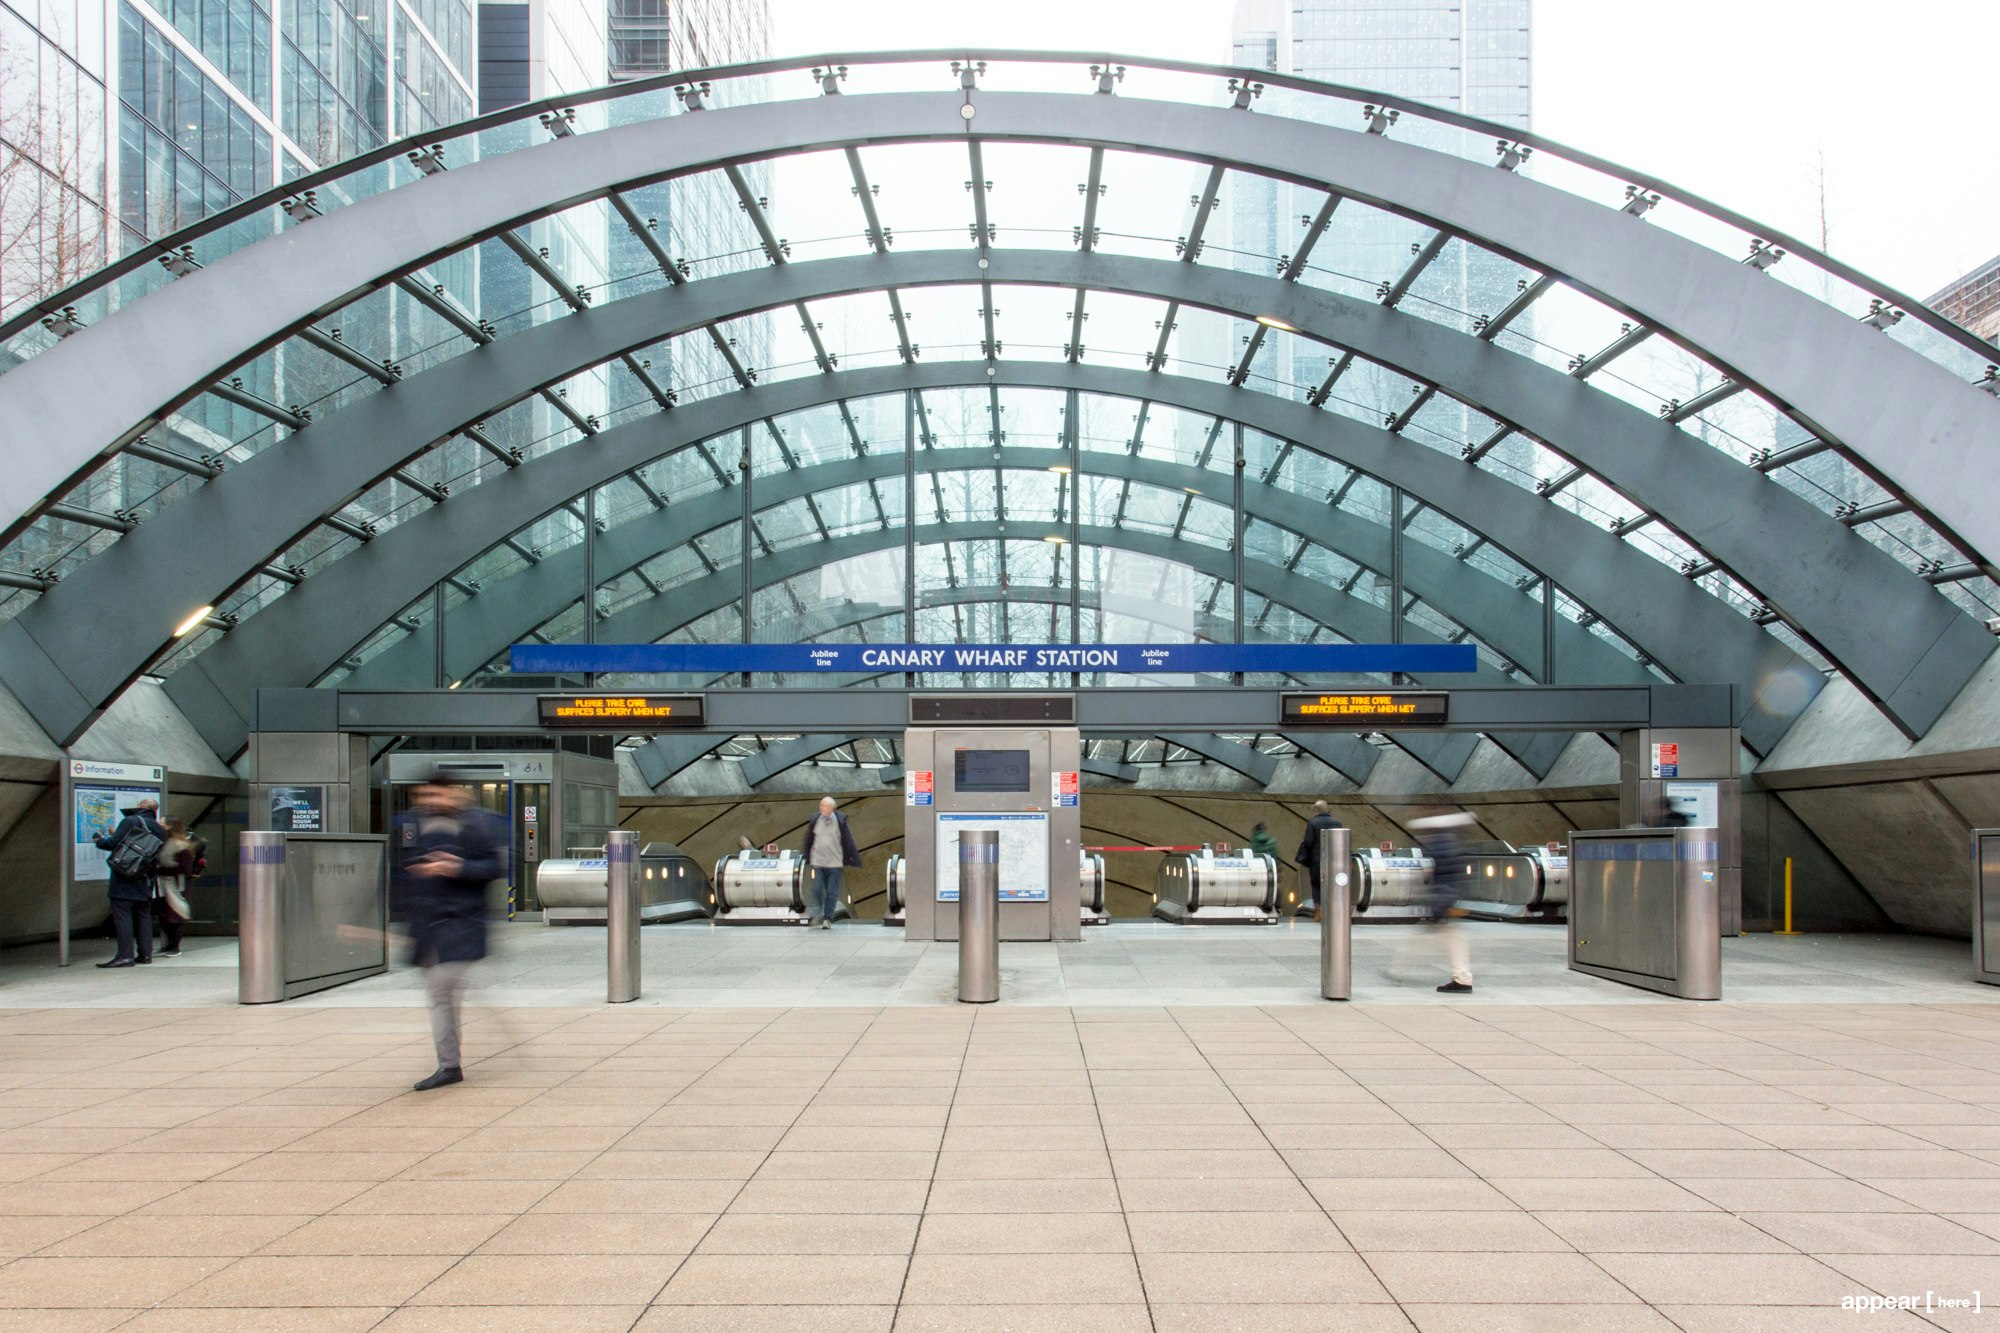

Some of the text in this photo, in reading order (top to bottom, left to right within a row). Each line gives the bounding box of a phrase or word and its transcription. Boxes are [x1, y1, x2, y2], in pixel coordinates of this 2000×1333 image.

[809, 649, 839, 658] Jubilee
[861, 649, 1119, 667] CANARY WHARF STATION
[1140, 649, 1170, 658] Jubilee
[816, 658, 832, 667] line
[1147, 657, 1163, 666] line
[575, 699, 647, 708] PLEASE TAKE CARE
[1320, 696, 1392, 705] PLEASE TAKE CARE
[557, 707, 671, 716] SURFACES SLIPPERY WHEN WET
[1300, 704, 1416, 714] SURFACES SLIPPERY WHEN WET
[85, 764, 125, 775] Information
